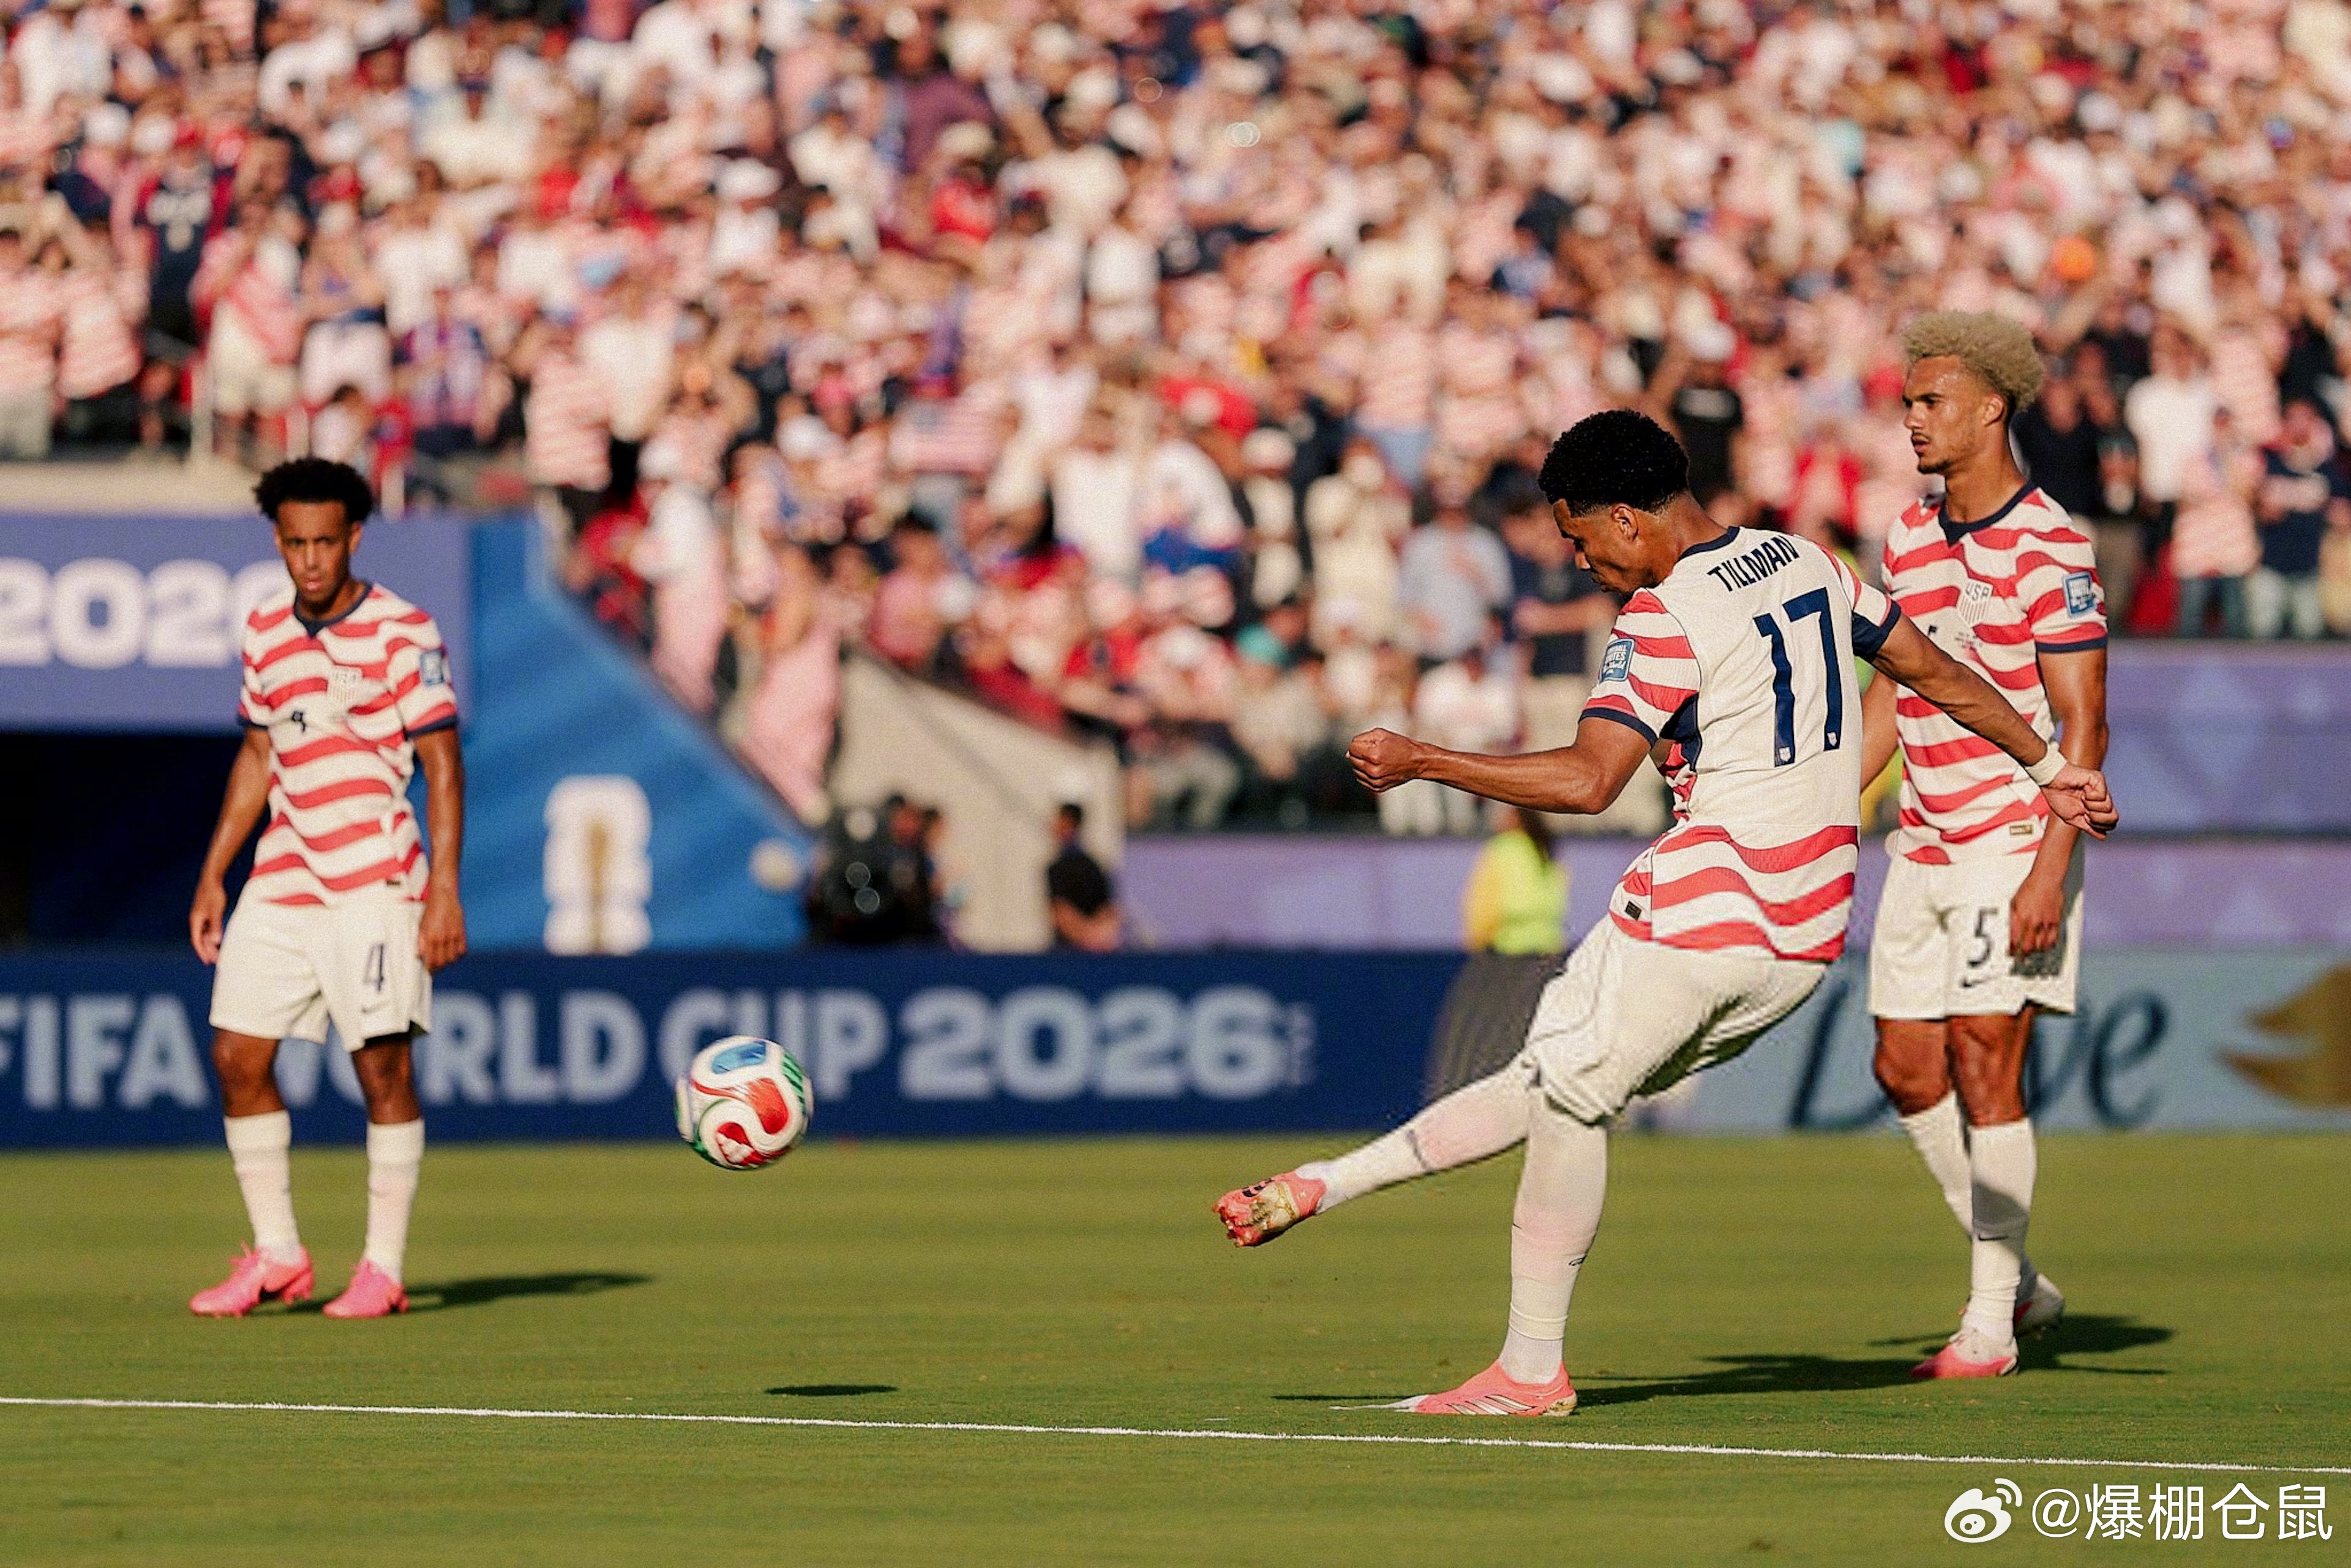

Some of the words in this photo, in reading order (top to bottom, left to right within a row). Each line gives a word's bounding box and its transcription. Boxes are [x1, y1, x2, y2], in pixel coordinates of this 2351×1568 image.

[1706, 535, 1800, 592] TILLMAN
[1965, 581, 1990, 601] USA
[1752, 586, 1843, 767] 17
[291, 710, 307, 733] 4
[1967, 906, 1999, 969] 5
[362, 943, 384, 992] 4
[899, 986, 1284, 1099] 2026
